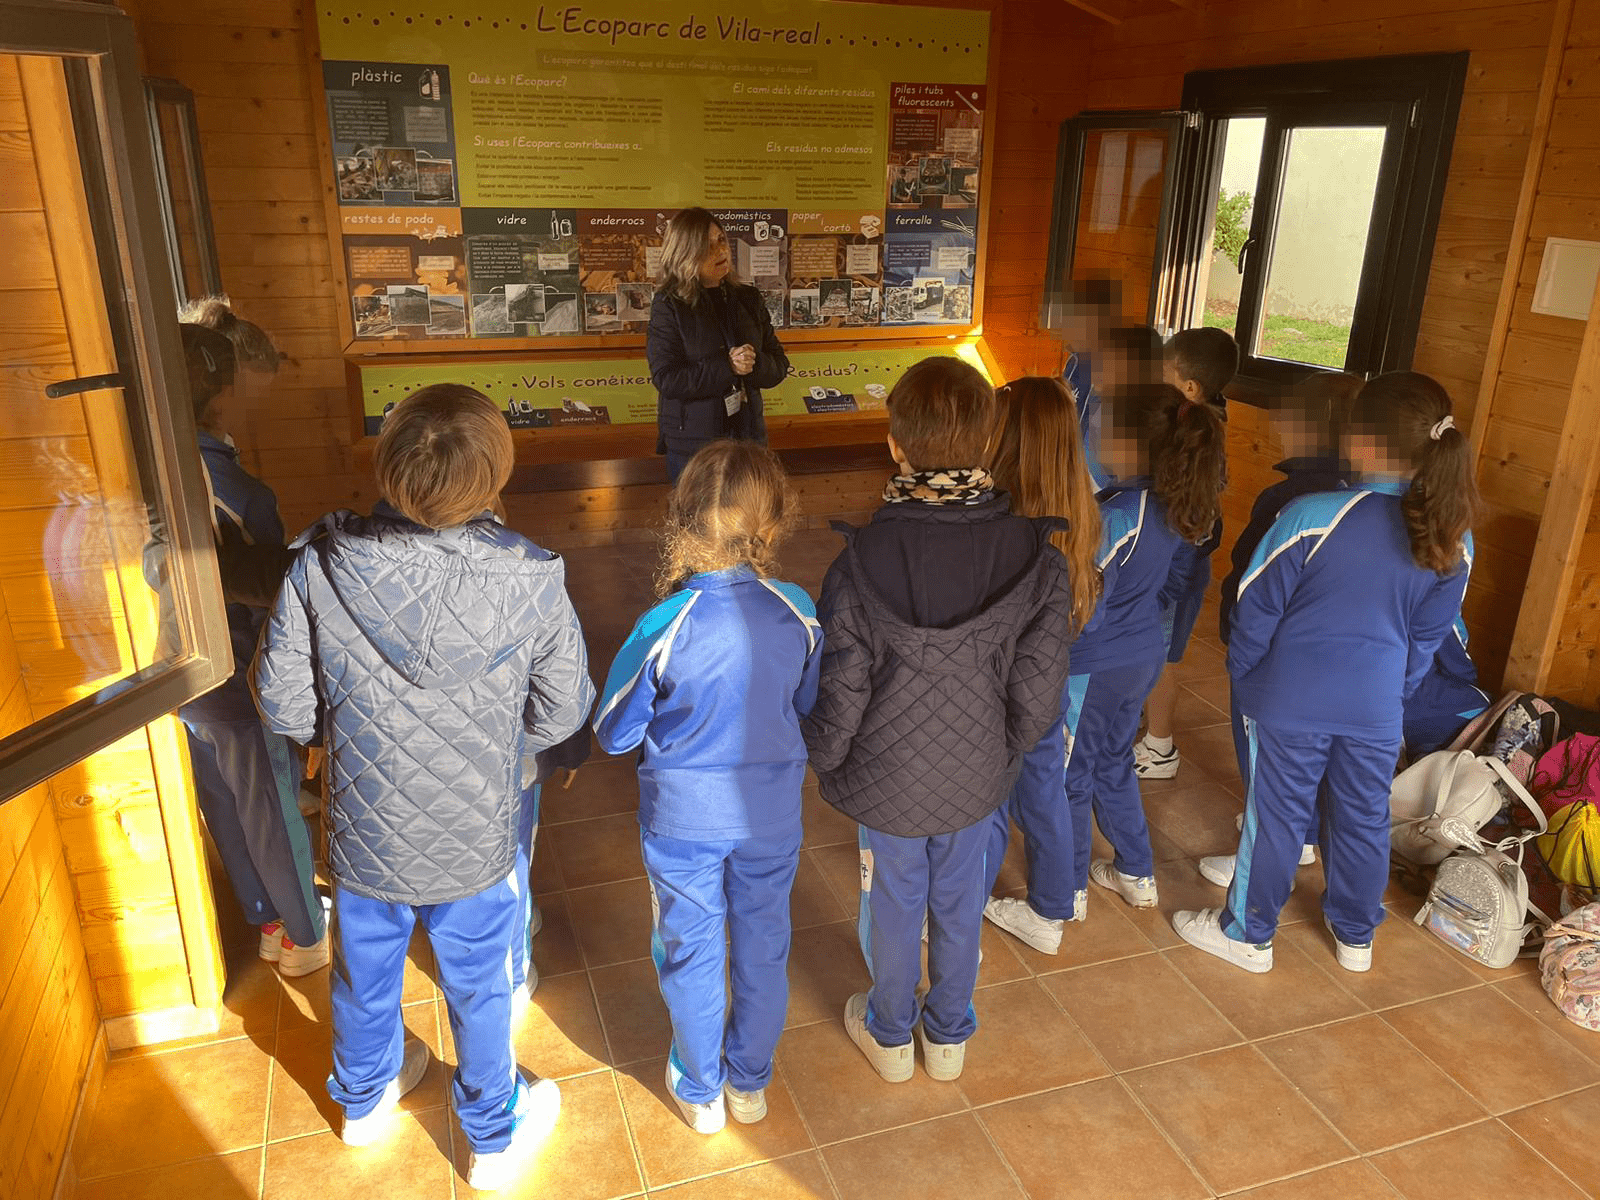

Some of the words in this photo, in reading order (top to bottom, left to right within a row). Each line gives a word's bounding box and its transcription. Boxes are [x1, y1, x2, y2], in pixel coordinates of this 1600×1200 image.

[537, 4, 670, 46] L'Ecoparc
[679, 15, 707, 40] de
[716, 16, 821, 45] Vila-real
[351, 67, 403, 87] plàstic
[793, 84, 840, 97] diferents
[841, 88, 876, 97] residus
[894, 83, 917, 98] piles
[918, 86, 923, 95] i
[924, 85, 944, 96] tubs
[898, 95, 956, 107] fluorescents
[486, 139, 511, 147] uses
[766, 141, 782, 153] Els
[783, 142, 818, 153] residus
[820, 145, 833, 153] no
[834, 143, 874, 154] admesos
[344, 213, 384, 224] restes
[387, 212, 402, 224] de
[404, 212, 435, 228] poda
[497, 213, 528, 225] vidre
[590, 214, 646, 226] enderrocs
[791, 212, 823, 224] paper
[895, 214, 933, 225] ferralla
[521, 375, 566, 389] Vols
